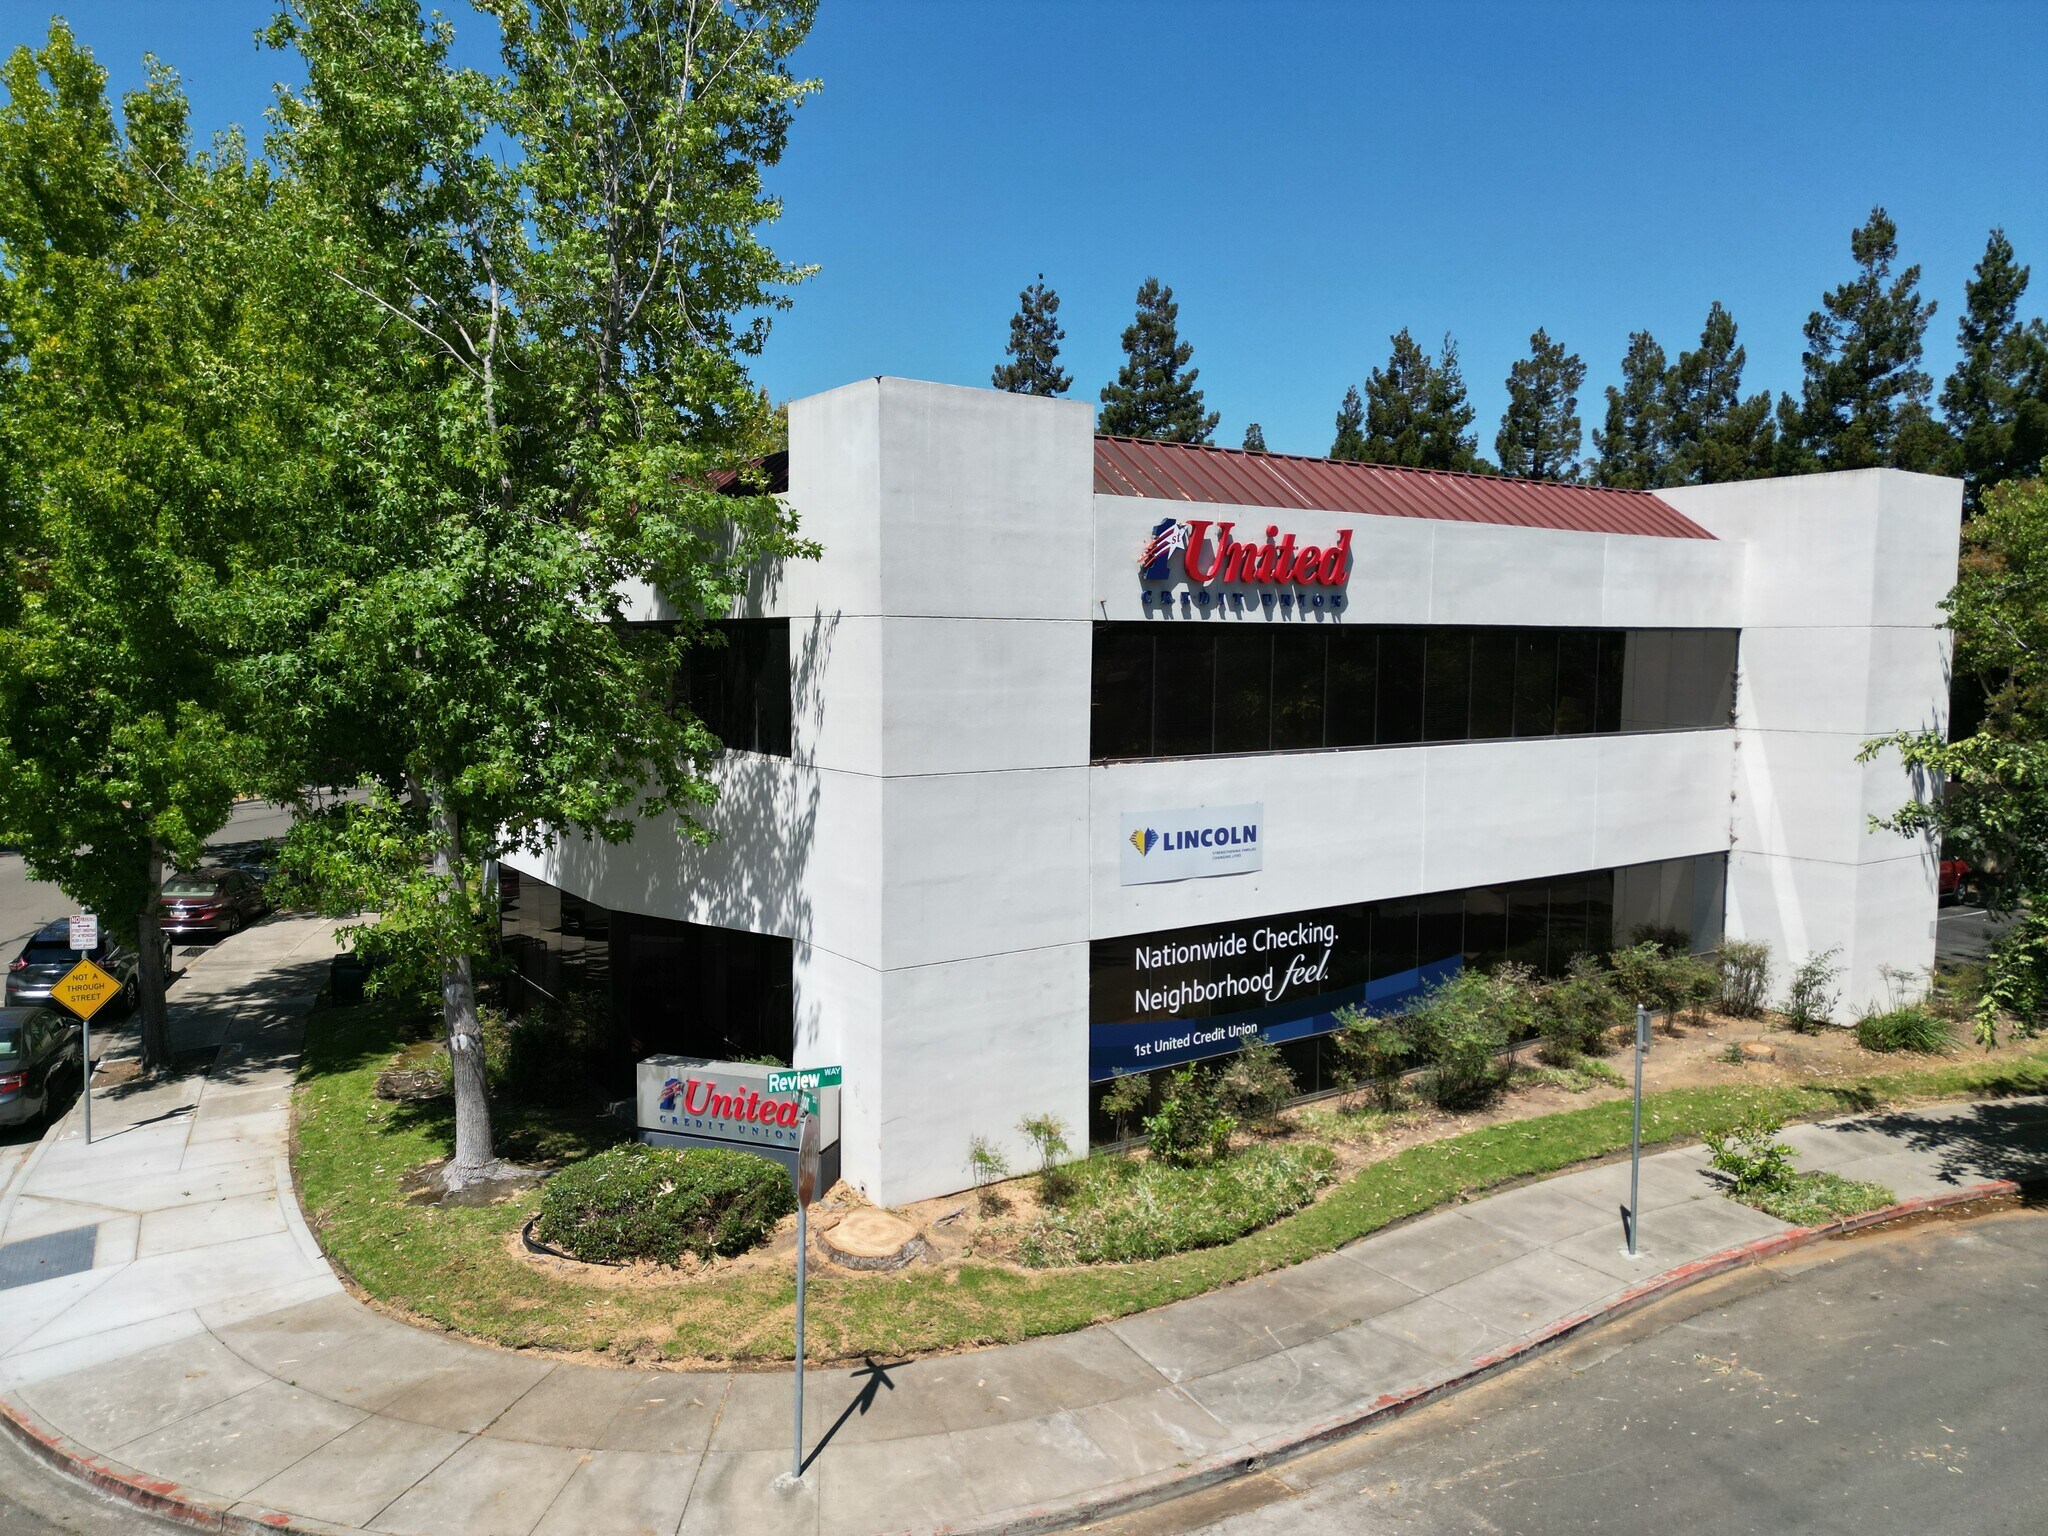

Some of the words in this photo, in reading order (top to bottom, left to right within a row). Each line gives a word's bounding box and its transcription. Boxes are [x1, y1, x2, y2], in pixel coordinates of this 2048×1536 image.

[1184, 520, 1354, 586] United
[1141, 590, 1243, 606] CREDIT
[1261, 593, 1342, 608] UNION
[1163, 825, 1257, 851] LINCOLN
[71, 916, 80, 924] NO
[1135, 932, 1247, 971] Nationwide
[1252, 922, 1339, 951] Checking.
[67, 982, 105, 992] THROUGH
[72, 974, 88, 982] NOT
[1135, 966, 1274, 1014] Neighborhood
[1265, 949, 1331, 1002] feel.
[71, 993, 101, 1003] STREET
[1134, 1042, 1151, 1057] 1st
[1154, 1033, 1190, 1052] United
[1193, 1026, 1226, 1045] Credit
[1228, 1022, 1258, 1037] Union
[768, 1071, 820, 1094] Review
[824, 1067, 841, 1077] WAY
[683, 1079, 799, 1129] United
[659, 1114, 725, 1131] CREDIT
[738, 1124, 798, 1140] UNION
